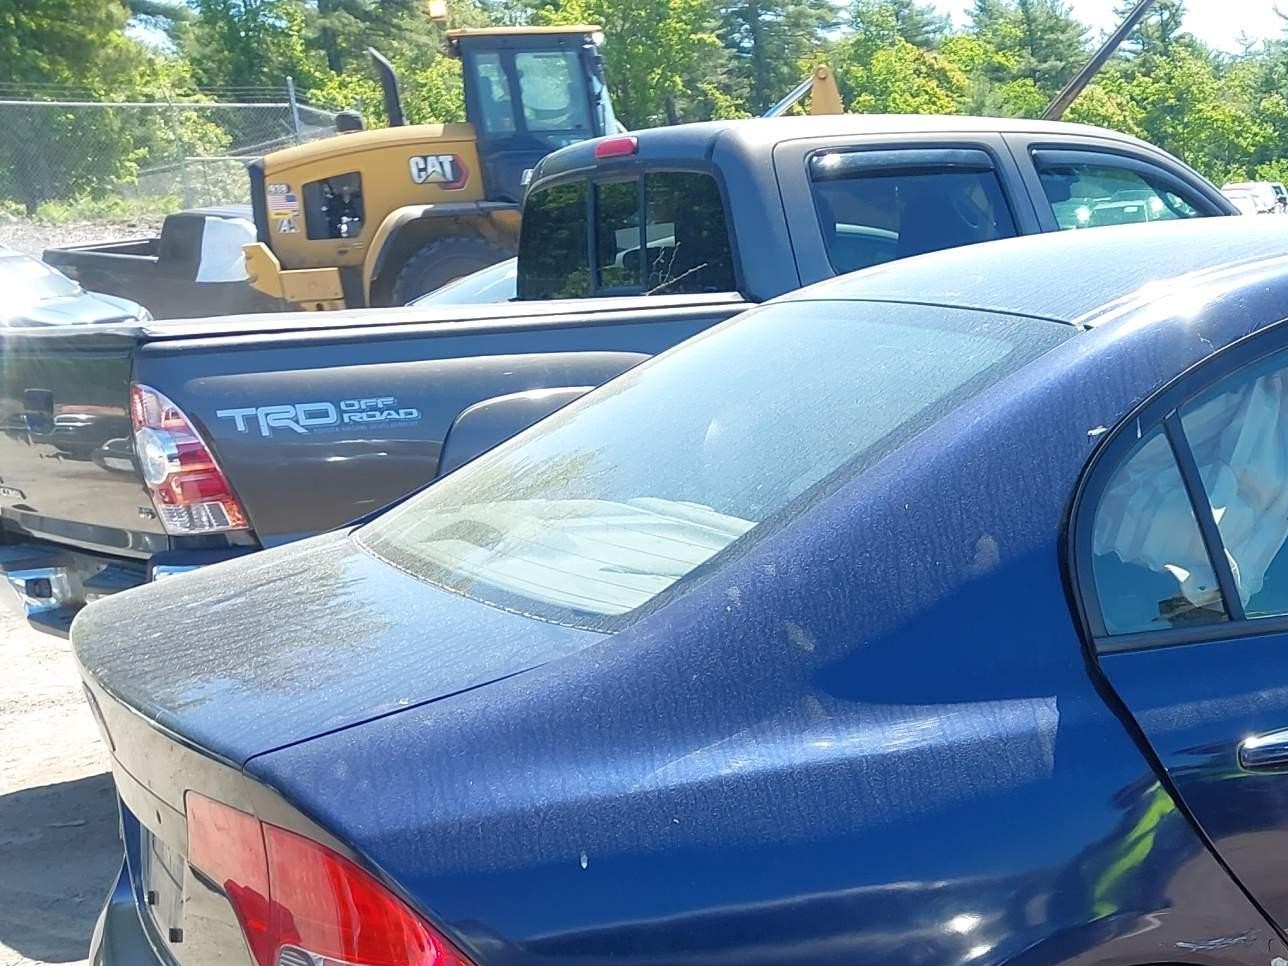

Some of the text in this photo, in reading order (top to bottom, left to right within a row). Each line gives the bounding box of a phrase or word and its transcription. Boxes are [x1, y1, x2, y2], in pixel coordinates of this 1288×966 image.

[409, 154, 455, 184] CAT
[340, 397, 397, 411] OFF
[216, 402, 340, 437] TRD
[342, 408, 420, 423] ROAD
